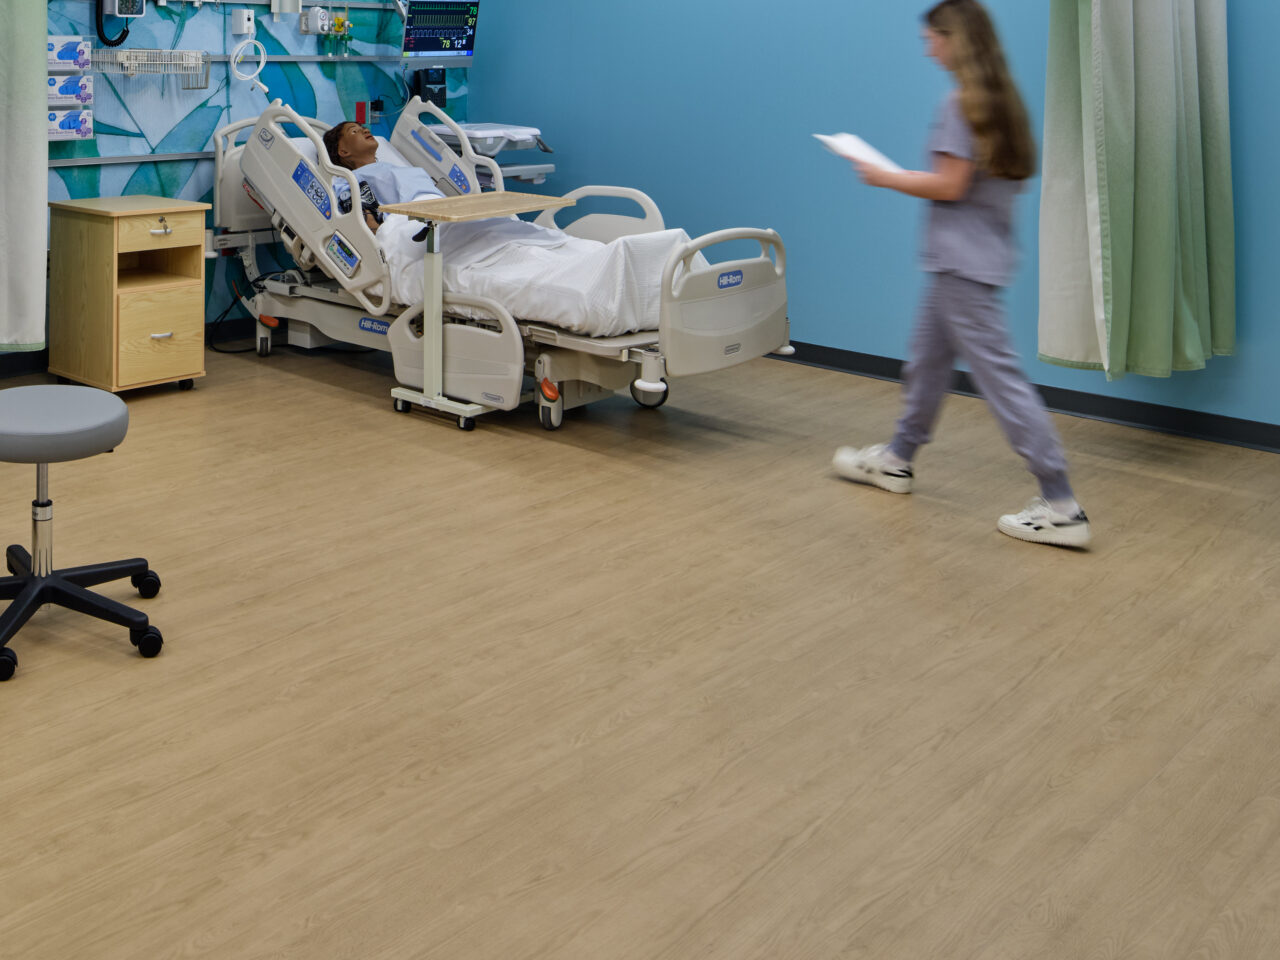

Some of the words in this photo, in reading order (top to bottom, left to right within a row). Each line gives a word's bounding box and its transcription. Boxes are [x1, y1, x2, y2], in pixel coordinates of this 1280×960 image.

[469, 6, 478, 15] 78
[467, 18, 476, 26] 97
[442, 40, 451, 48] 78
[454, 40, 462, 48] 12
